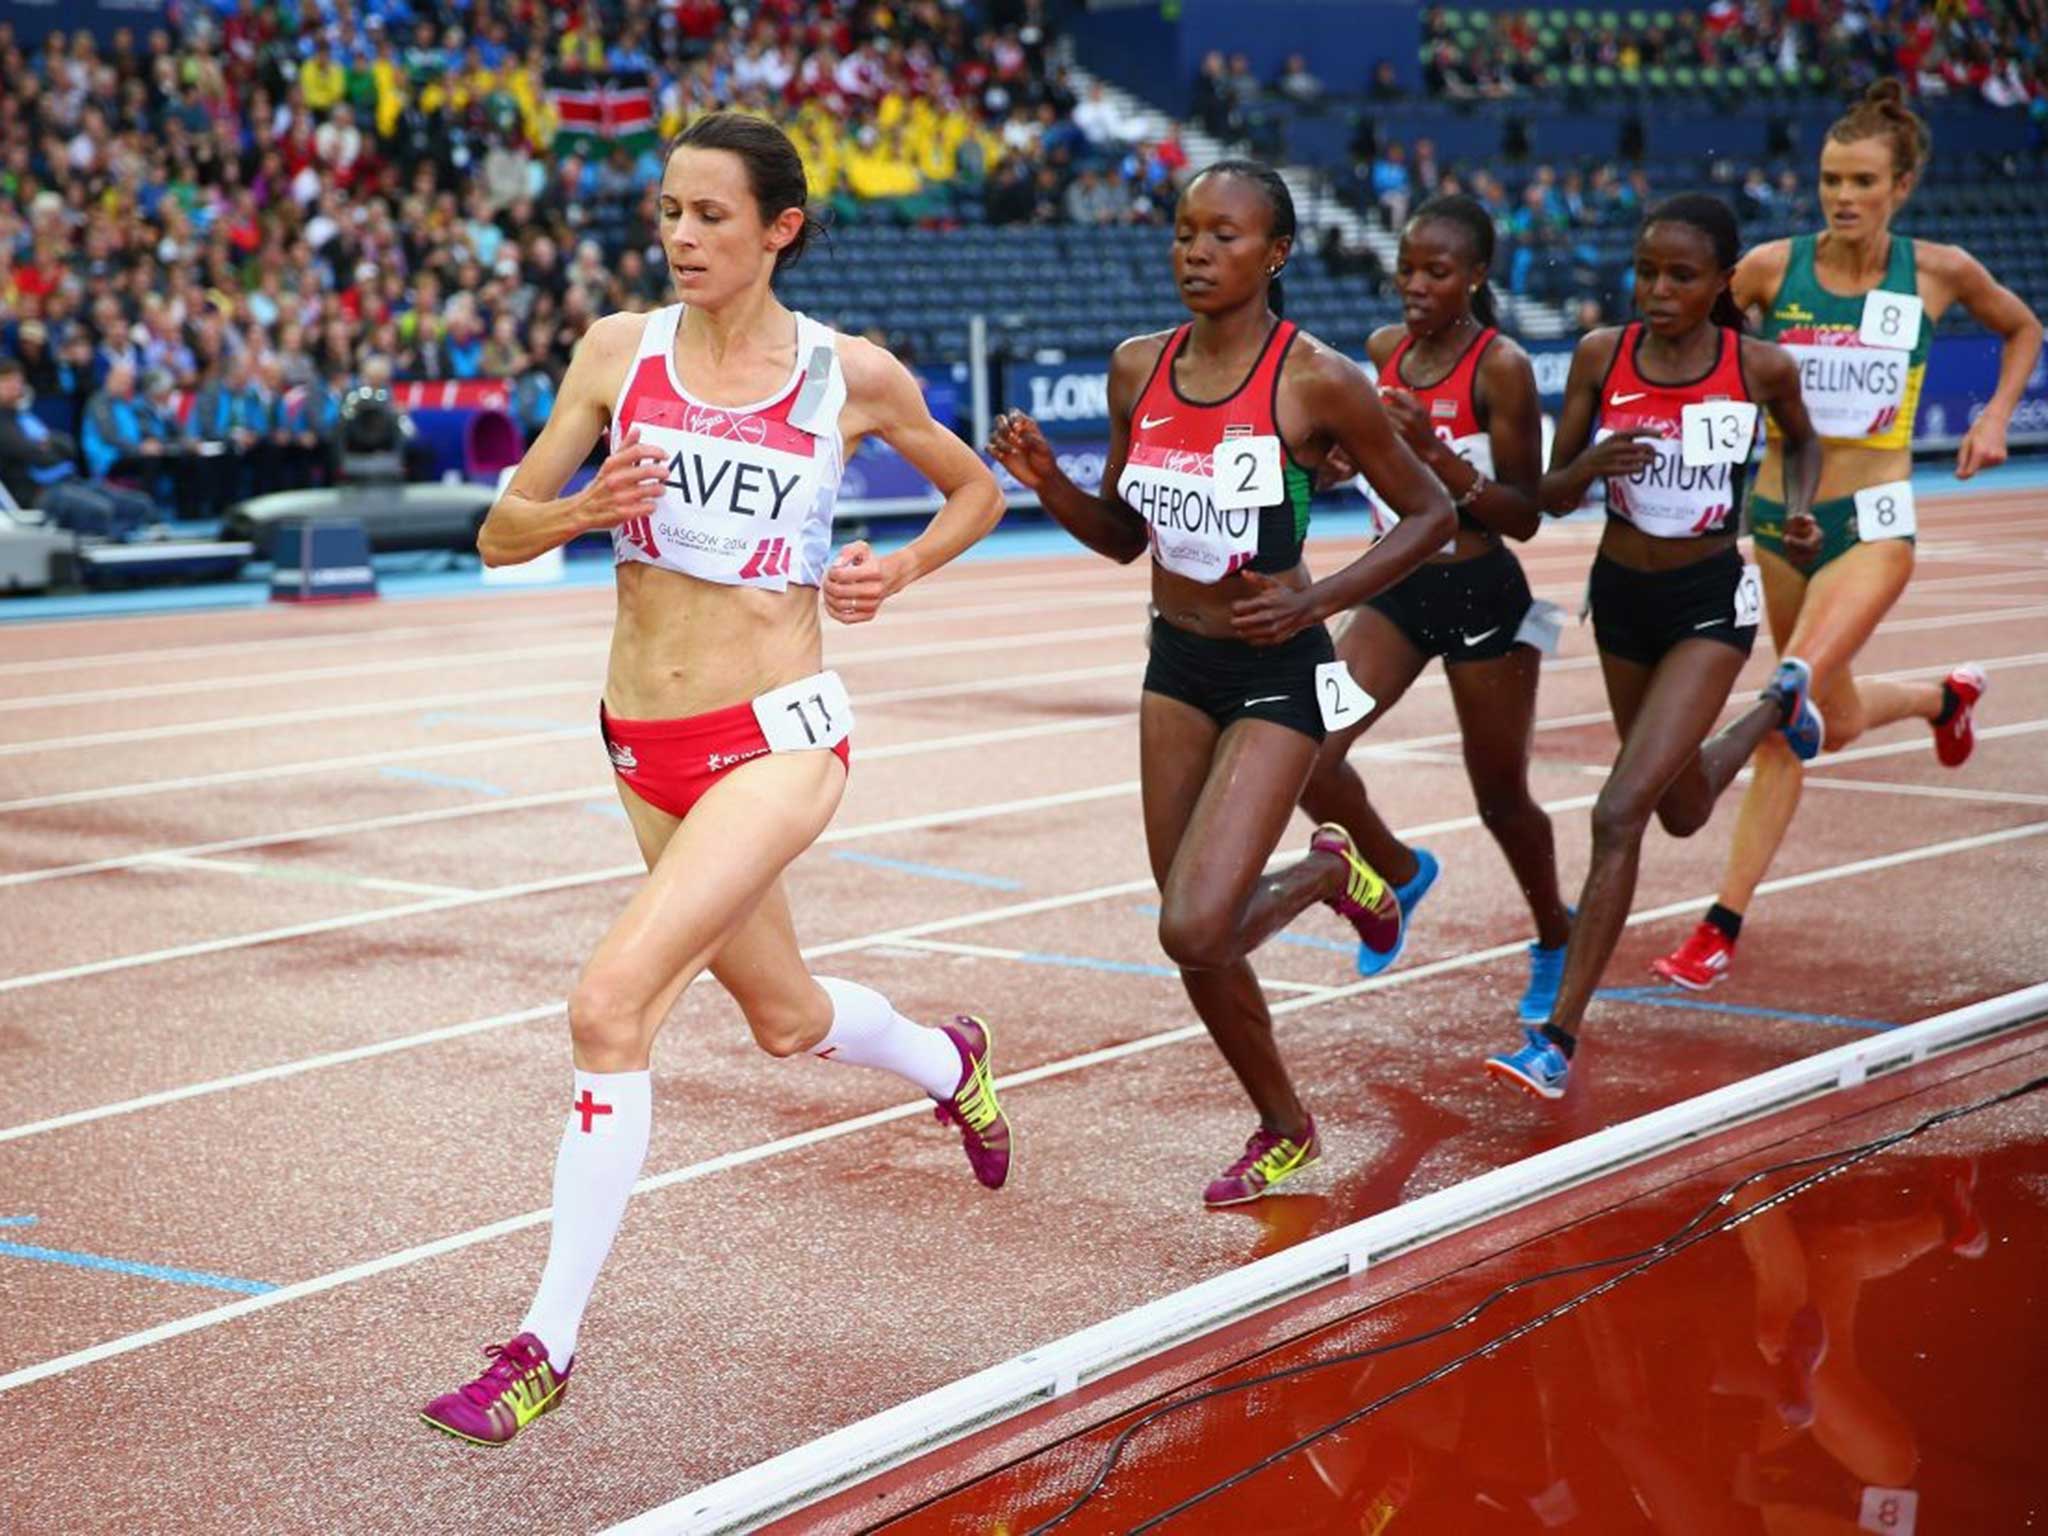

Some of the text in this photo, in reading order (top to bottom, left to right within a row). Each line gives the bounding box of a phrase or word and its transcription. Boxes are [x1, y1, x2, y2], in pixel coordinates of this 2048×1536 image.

[1880, 305, 1901, 336] 8
[1701, 414, 1741, 451] 13
[658, 450, 801, 520] AVEY
[1233, 452, 1259, 493] 2
[1628, 452, 1728, 491] URIUKI
[1125, 479, 1250, 539] CHERONO
[1875, 496, 1897, 527] 8
[658, 522, 719, 546] GLASGOW
[1325, 678, 1350, 715] 2
[786, 693, 832, 745] 11
